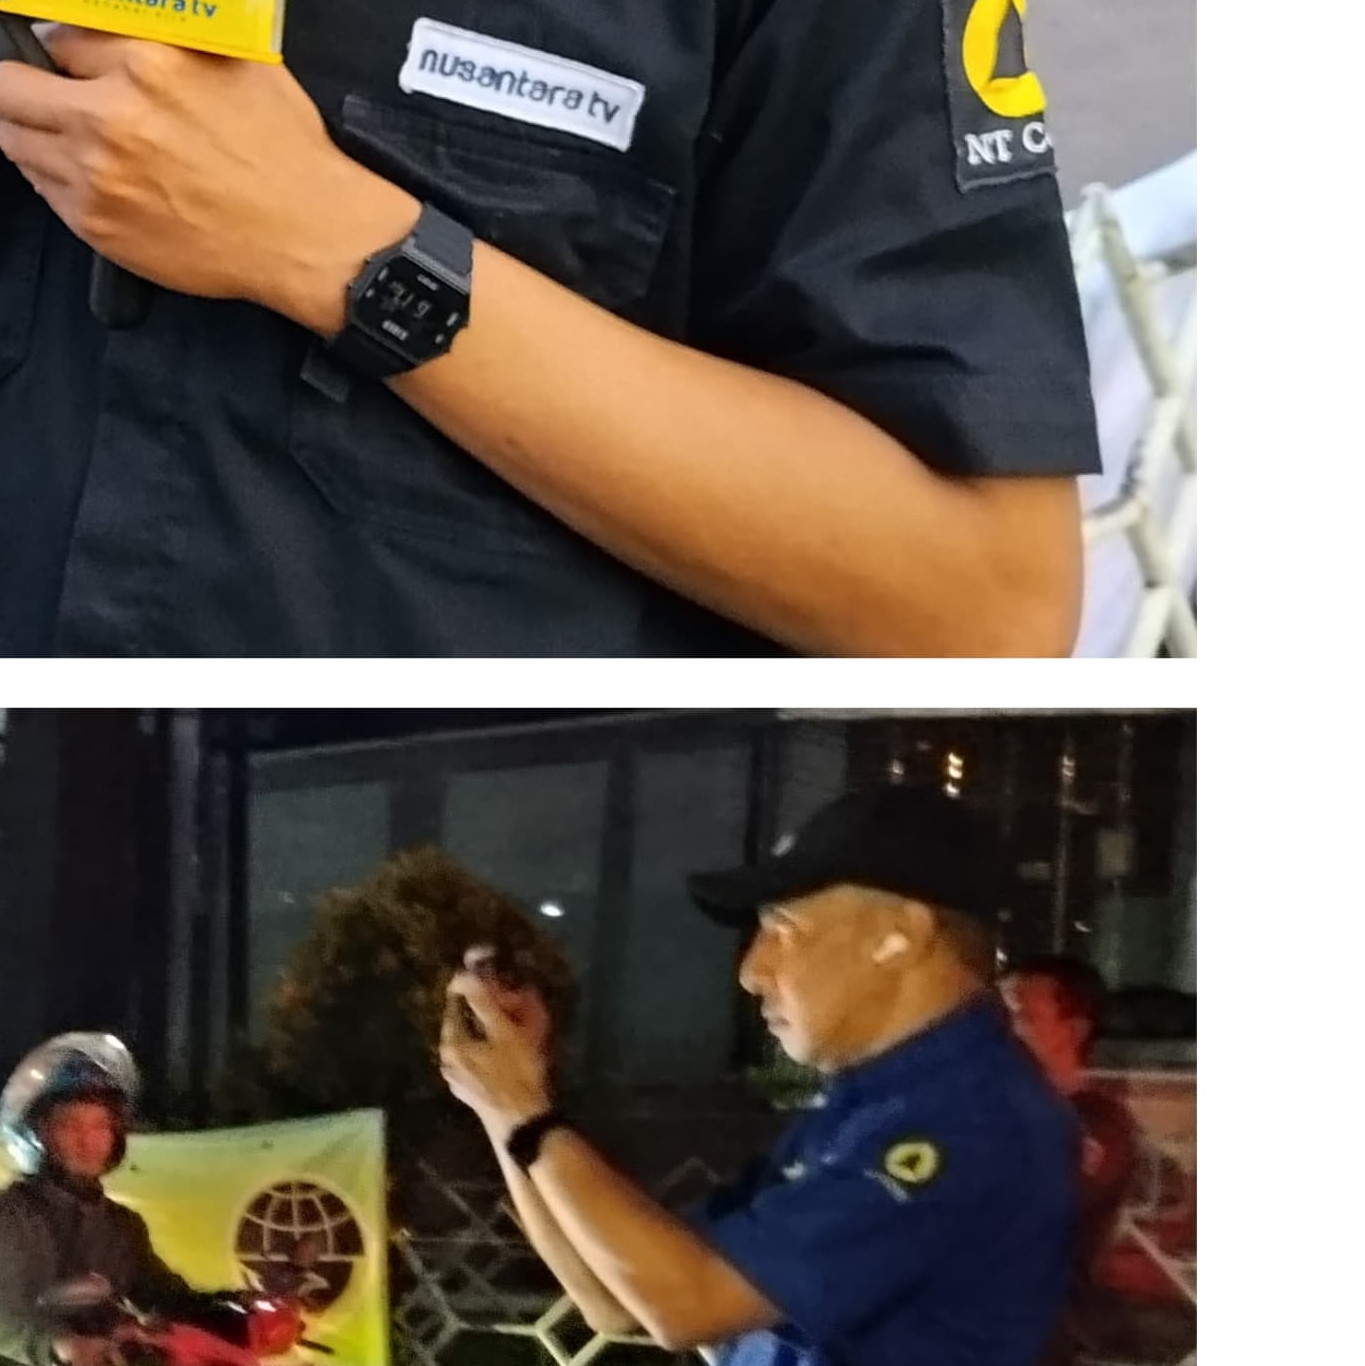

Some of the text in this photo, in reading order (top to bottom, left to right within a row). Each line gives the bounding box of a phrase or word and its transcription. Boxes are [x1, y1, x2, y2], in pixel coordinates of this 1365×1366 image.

[418, 49, 621, 124] nusantara tv
[964, 121, 1054, 165] NT C
